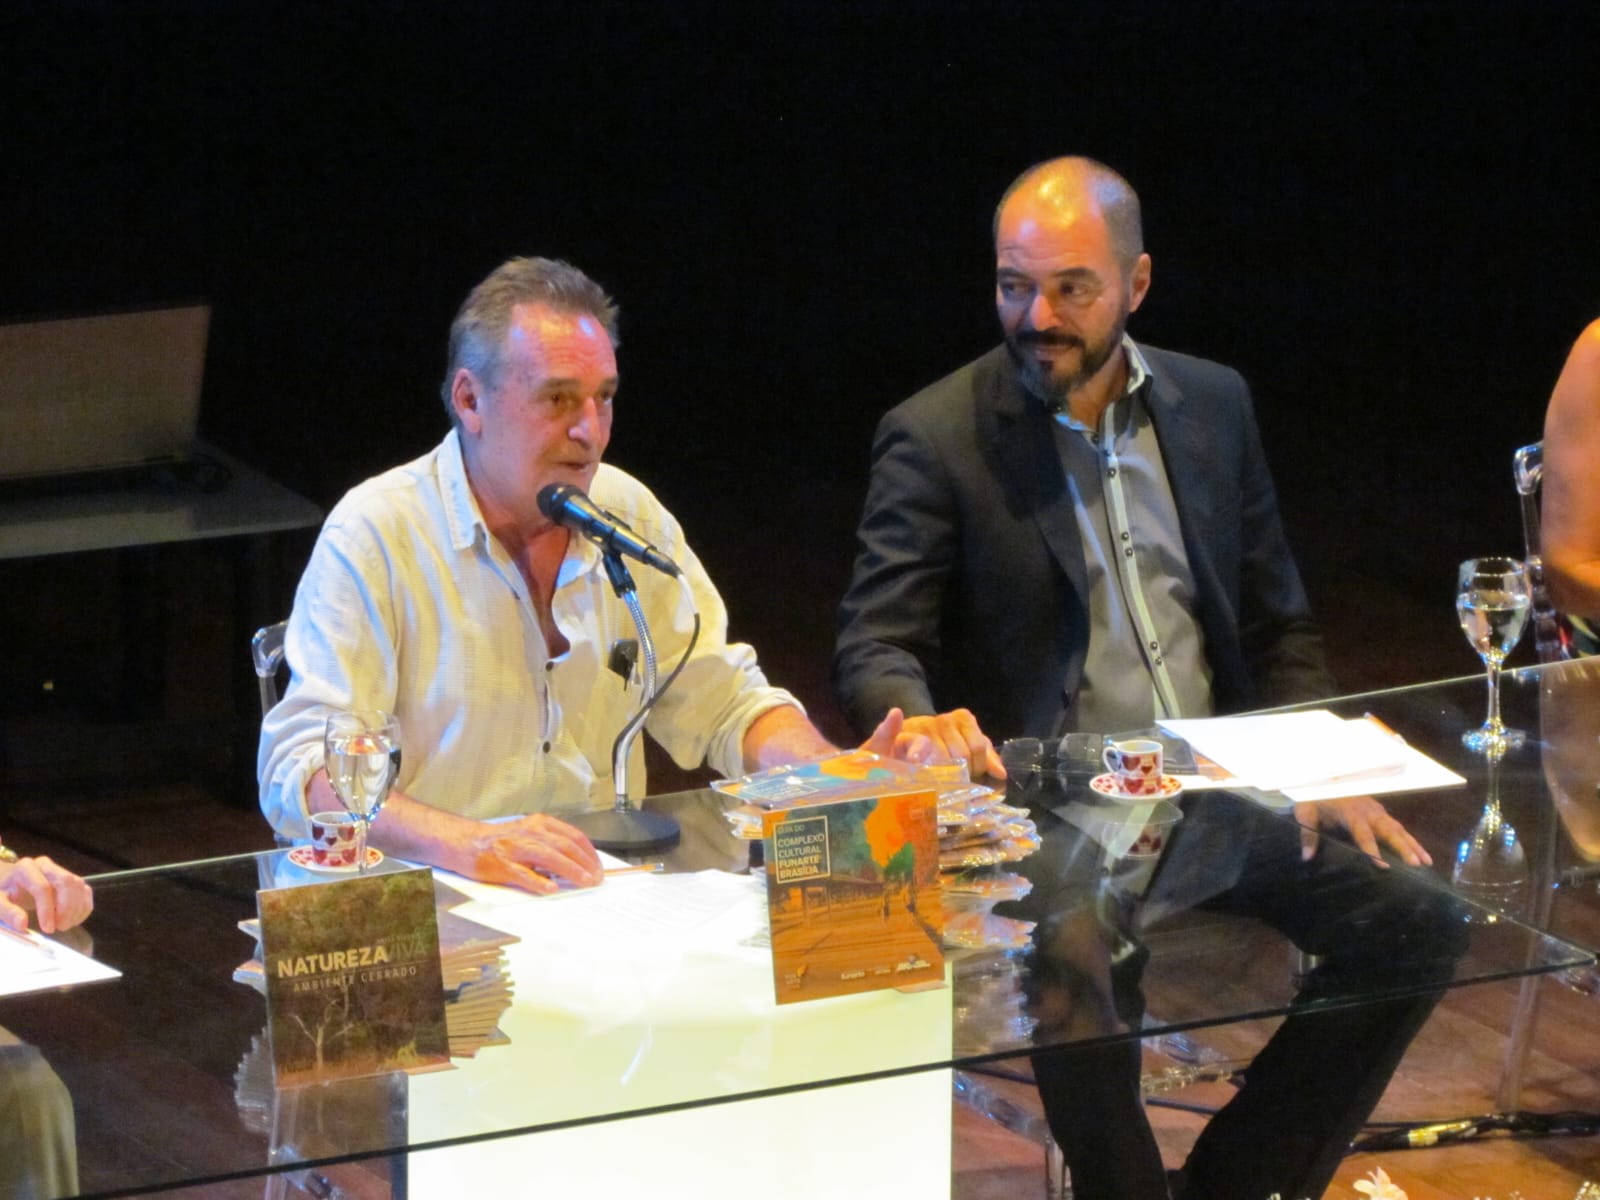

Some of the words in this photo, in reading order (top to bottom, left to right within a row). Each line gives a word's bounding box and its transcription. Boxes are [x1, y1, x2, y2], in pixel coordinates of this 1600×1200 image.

[778, 833, 825, 848] COMPLEXO
[778, 845, 822, 858] CULTURAL
[779, 854, 821, 868] FUNARTE
[278, 945, 389, 978] NATUREZA
